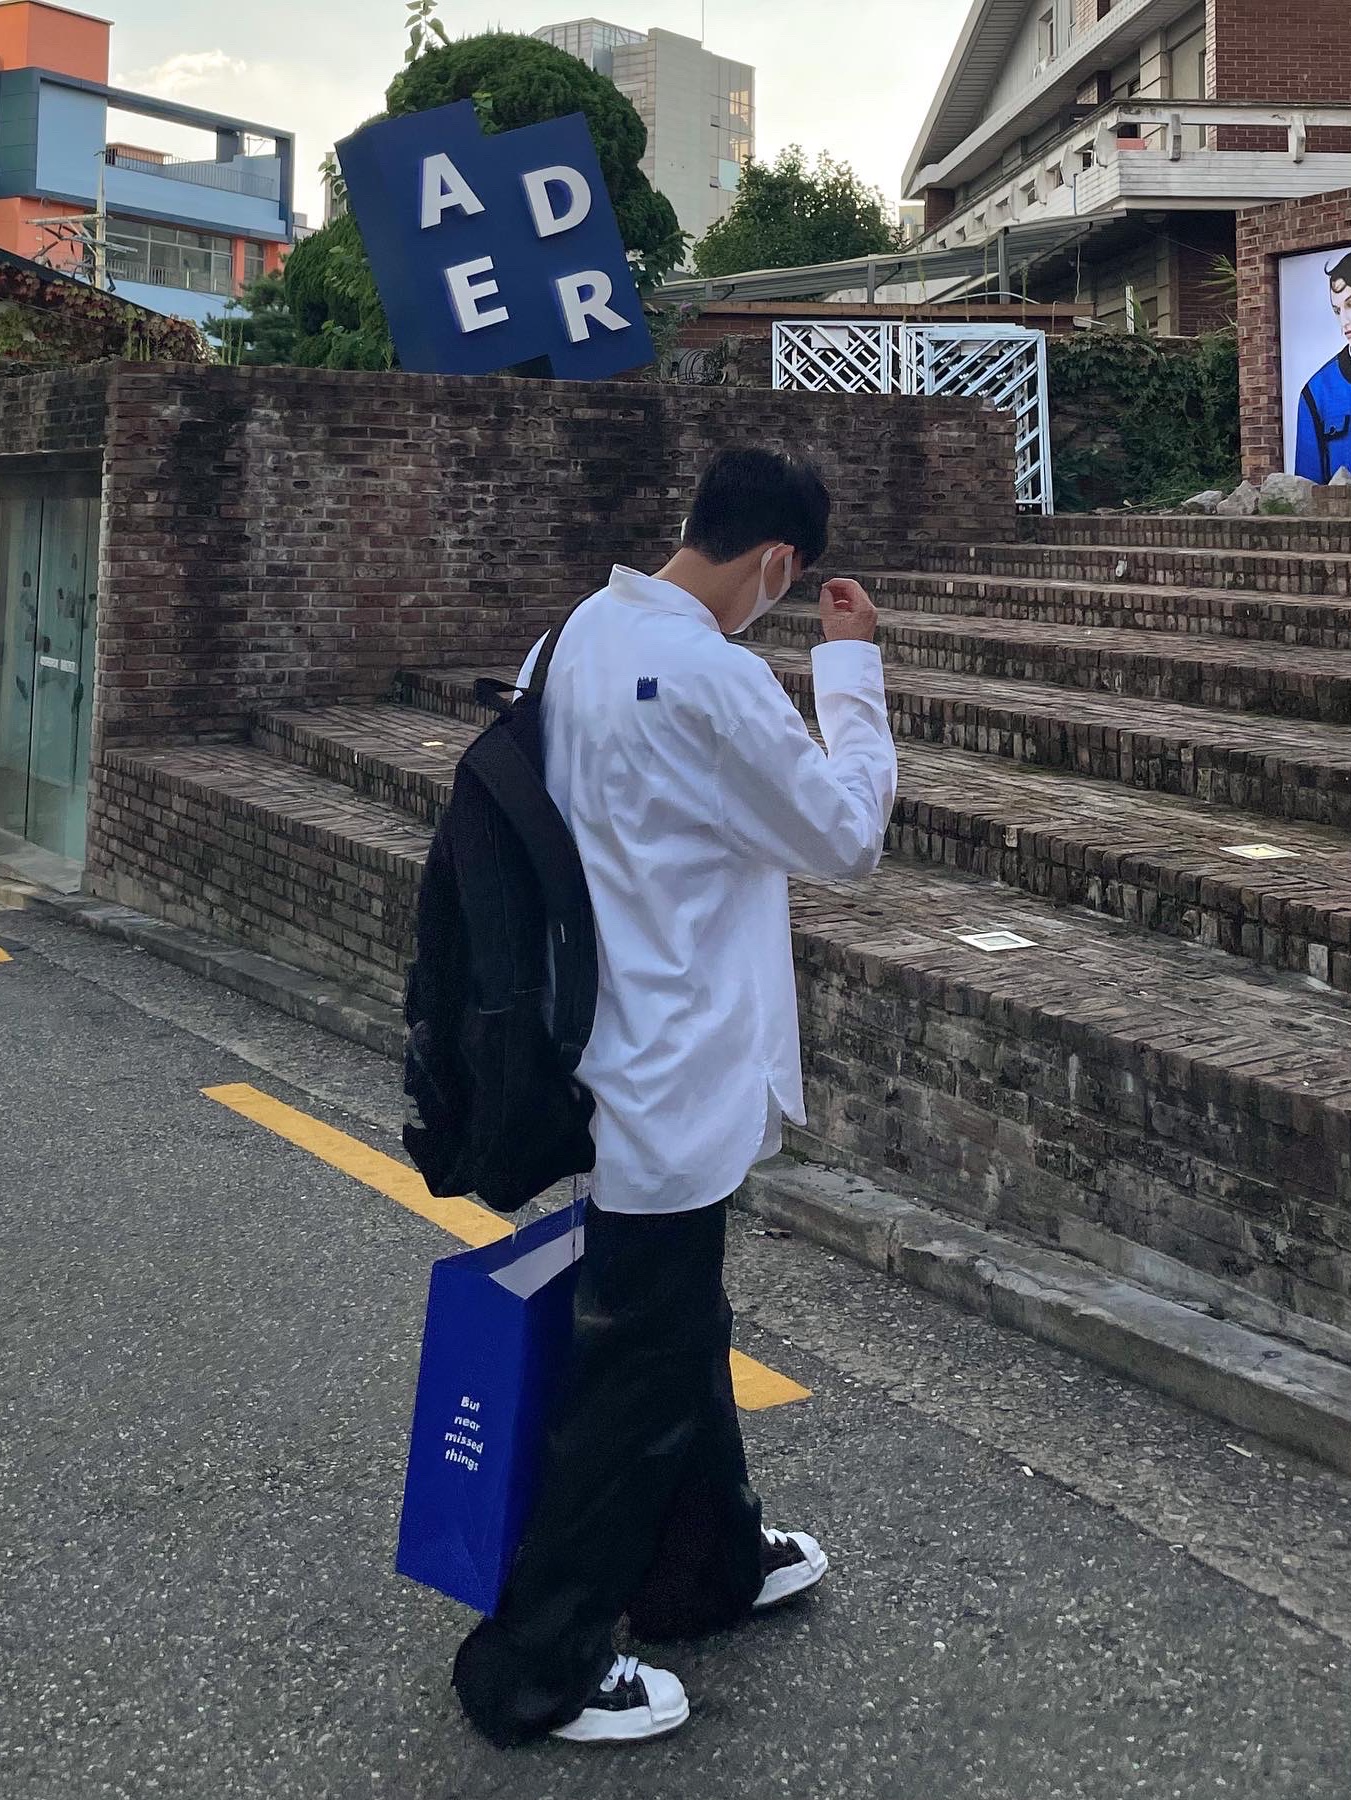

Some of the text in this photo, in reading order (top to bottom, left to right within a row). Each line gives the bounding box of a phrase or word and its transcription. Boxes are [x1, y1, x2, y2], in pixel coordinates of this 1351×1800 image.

[461, 1396, 480, 1412] But
[454, 1416, 480, 1431] near
[445, 1432, 484, 1454] missed
[445, 1448, 479, 1471] things
